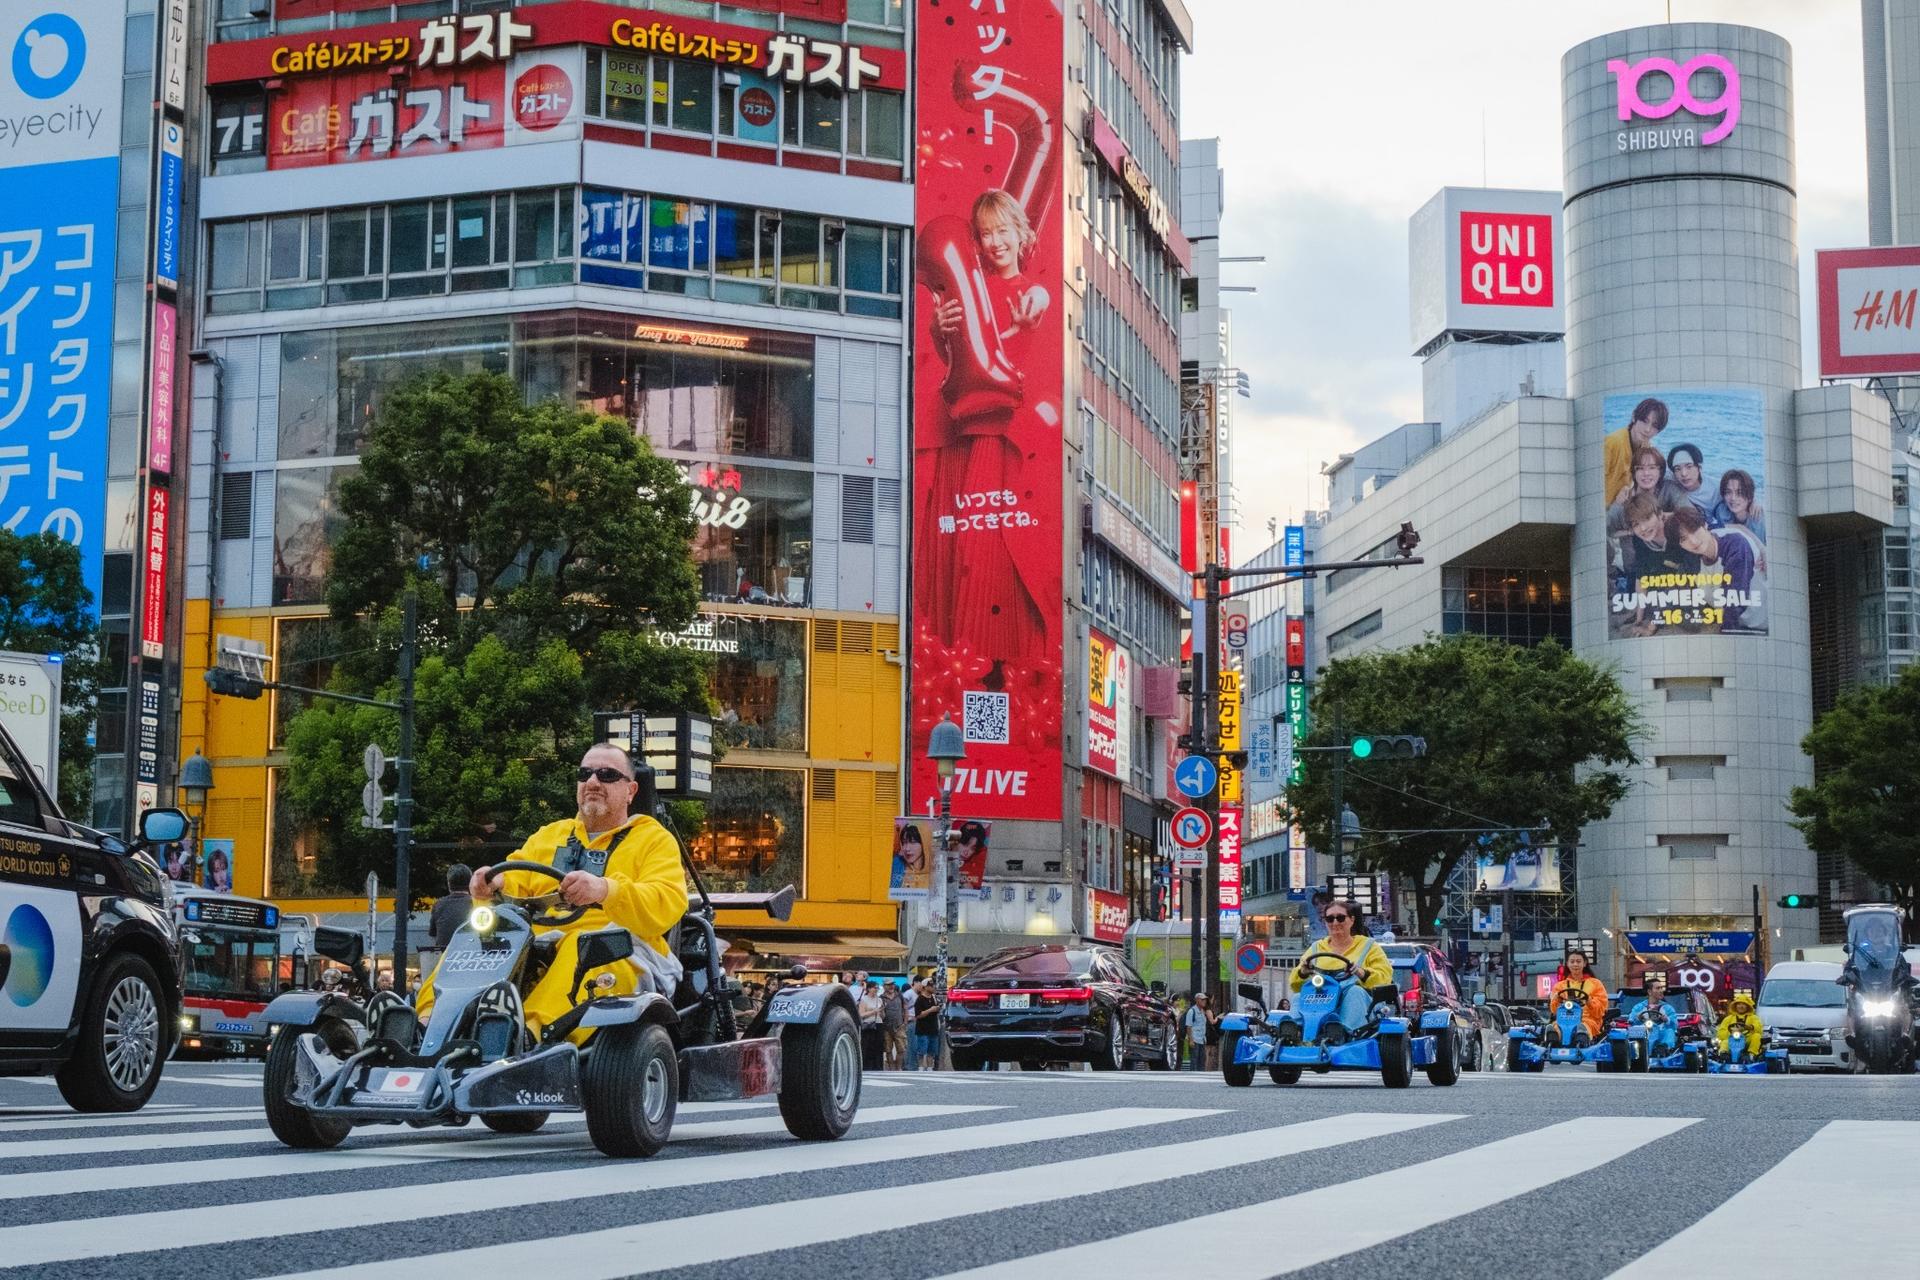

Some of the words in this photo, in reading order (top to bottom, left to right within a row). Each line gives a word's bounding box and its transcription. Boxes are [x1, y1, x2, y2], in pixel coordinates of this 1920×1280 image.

[170, 0, 183, 86] 血ルーム
[418, 12, 532, 66] ガスト
[609, 60, 645, 76] OPEN
[766, 35, 881, 90] ガスト
[520, 92, 566, 113] ガスト
[1608, 53, 1741, 146] 109
[0, 104, 102, 148] eyecity
[216, 114, 264, 153] 7F
[282, 104, 341, 136] Café
[348, 86, 490, 156] ガスト
[1617, 128, 1695, 151] SHIBUYA
[1470, 223, 1536, 257] UNI
[1471, 263, 1543, 299] QLO
[1853, 288, 1918, 332] H&M
[40, 223, 94, 546] コンタクトの
[156, 334, 170, 445] 品川美容外科
[154, 453, 167, 467] 4F
[955, 489, 1018, 510] いつでも
[150, 490, 165, 572] 外貨両替
[938, 511, 1039, 534] 帰ってきてね。
[1612, 589, 1706, 612] SUMMER
[1713, 588, 1762, 607] SALE
[1259, 724, 1270, 777] 渋谷駅前
[16, 841, 41, 855] GROUP
[1158, 817, 1180, 860] LUS
[29, 861, 55, 876] KOTSU
[1219, 812, 1239, 906] スギ薬局
[445, 949, 515, 961] JAPAN
[1648, 938, 1700, 947] SUMMER
[1702, 938, 1730, 947] SALE
[446, 960, 506, 972] KART
[1678, 968, 1715, 993] 109
[534, 1092, 564, 1104] klook
